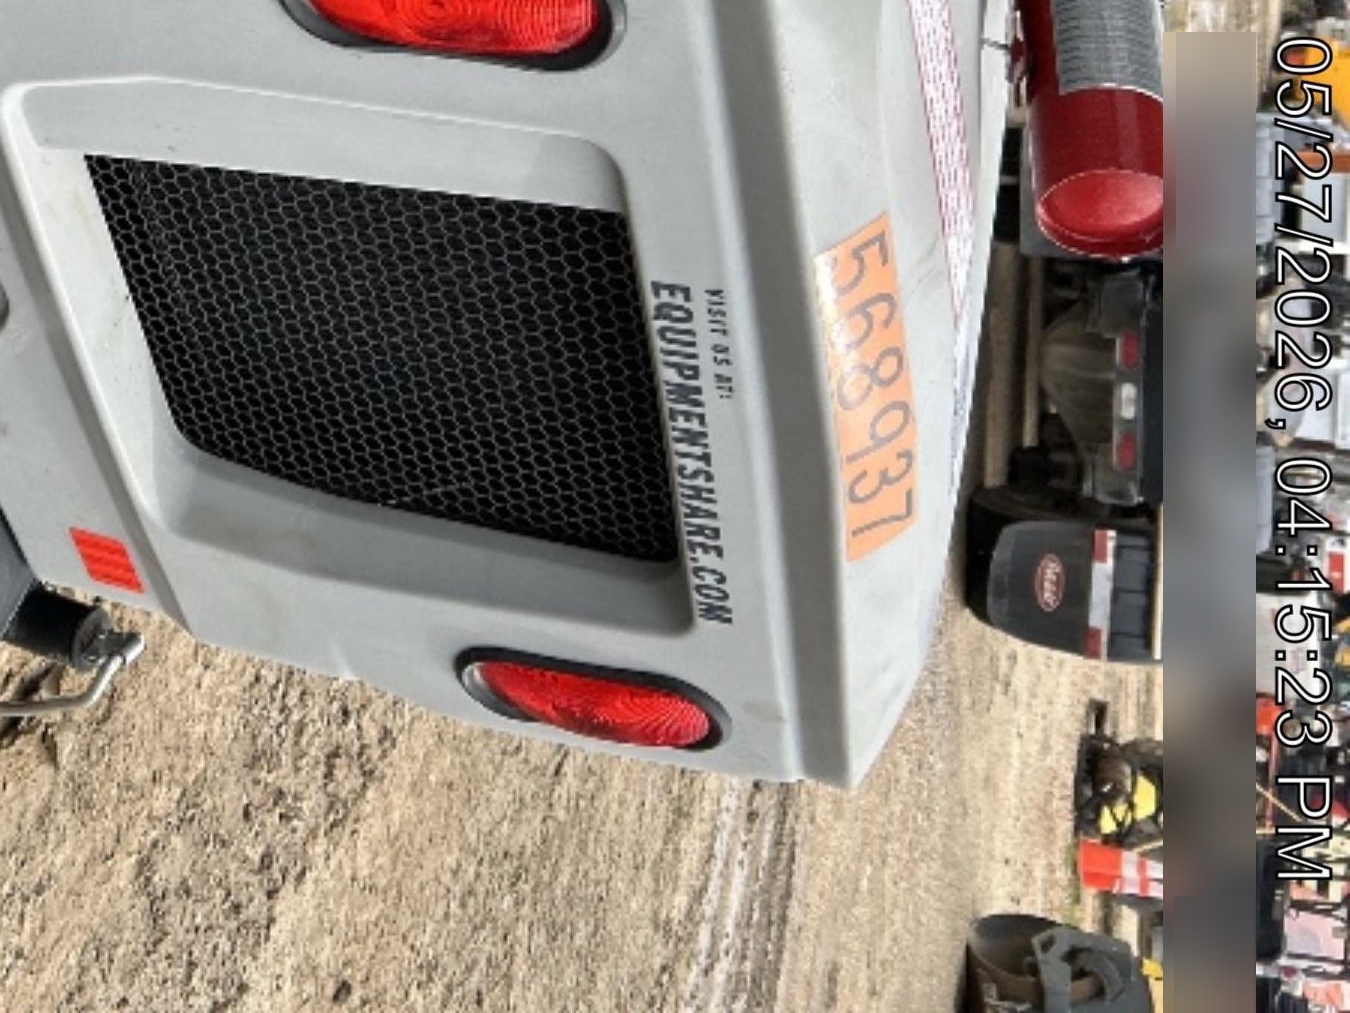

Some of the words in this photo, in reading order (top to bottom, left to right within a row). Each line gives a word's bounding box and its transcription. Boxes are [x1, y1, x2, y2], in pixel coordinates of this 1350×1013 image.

[703, 289, 727, 336] VISIT
[709, 344, 732, 366] US
[712, 373, 734, 399] AT:
[829, 230, 913, 537] 568937
[649, 280, 732, 625] EQUIPMENTSHARE.COM
